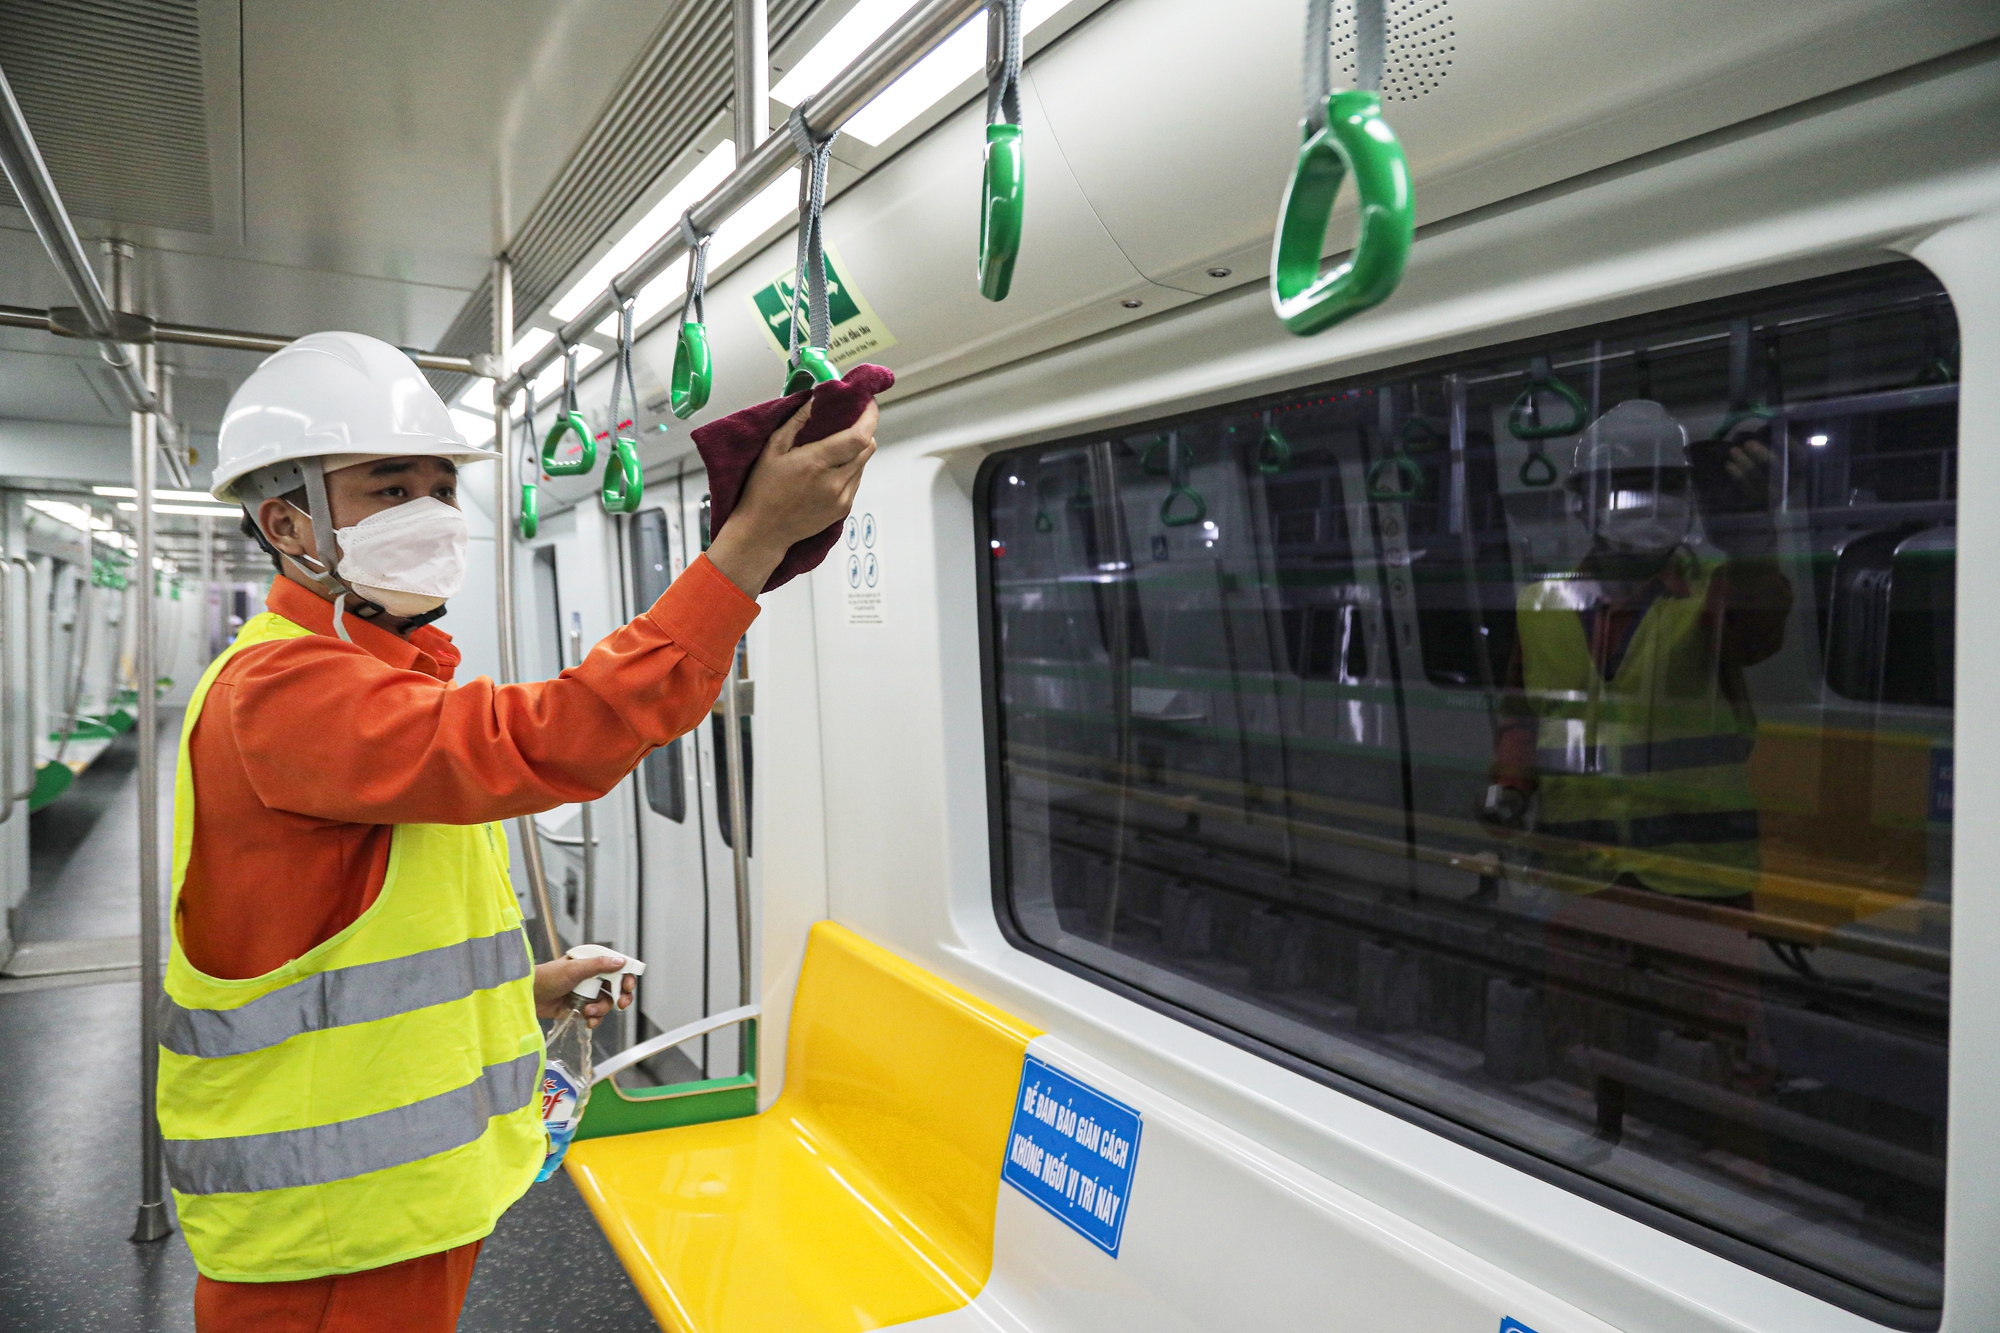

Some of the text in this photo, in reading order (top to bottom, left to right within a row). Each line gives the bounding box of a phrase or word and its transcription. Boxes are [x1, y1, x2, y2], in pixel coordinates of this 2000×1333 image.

[1023, 1081, 1129, 1170] ĐỂ ĐẢM BẢO GIÃN CÁCH
[1010, 1133, 1044, 1178] KHÔNG
[1066, 1167, 1080, 1208] VỊ
[1077, 1176, 1099, 1213] TRÍ
[1094, 1185, 1121, 1228] NÀY
